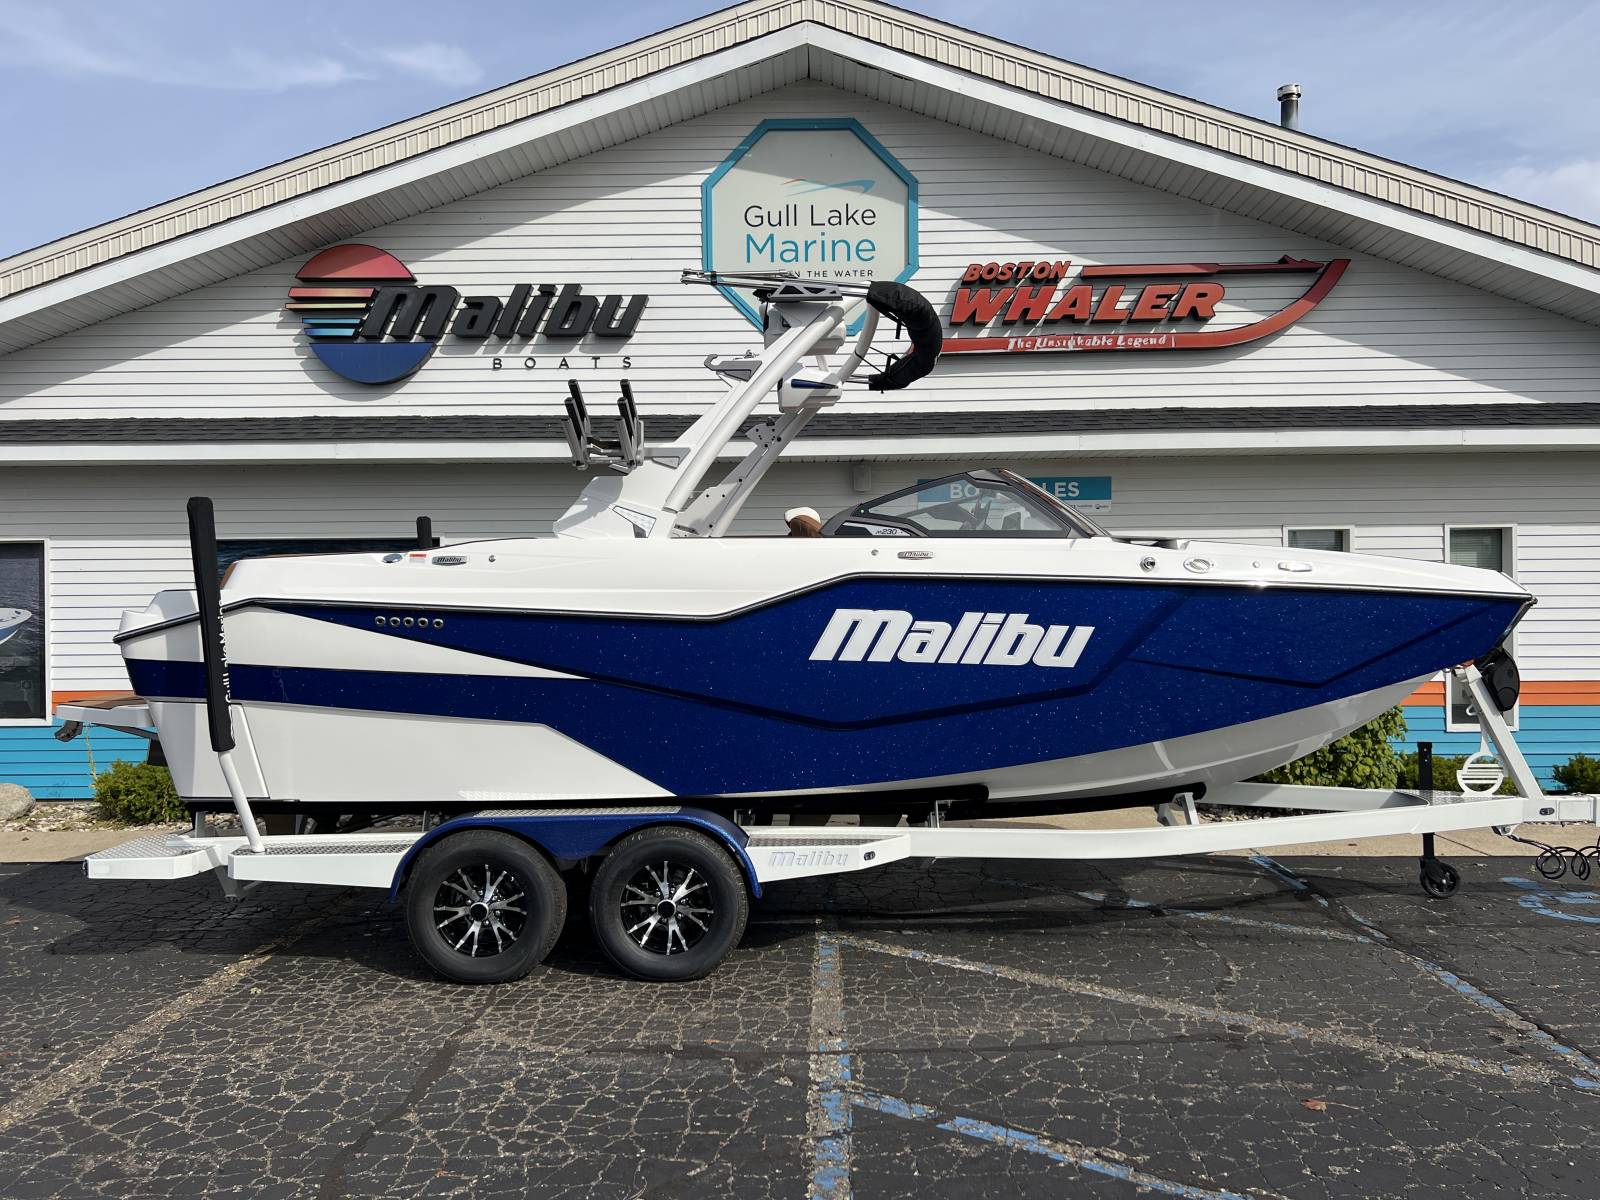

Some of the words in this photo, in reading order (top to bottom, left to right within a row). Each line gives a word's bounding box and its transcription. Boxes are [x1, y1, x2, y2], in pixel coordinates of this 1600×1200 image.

[743, 203, 798, 228] Gull
[810, 203, 876, 227] Lake
[745, 231, 876, 264] Marine
[807, 270, 828, 278] THE
[834, 269, 874, 278] WATER
[961, 260, 1071, 285] BOSTON
[357, 283, 650, 340] Malibu
[949, 282, 1226, 326] WHALER
[1007, 336, 1032, 351] The
[1116, 334, 1167, 349] Legend
[492, 356, 632, 370] BOATS
[950, 483, 980, 499] BO
[808, 608, 1096, 668] Malibu
[767, 850, 849, 867] Malibu
